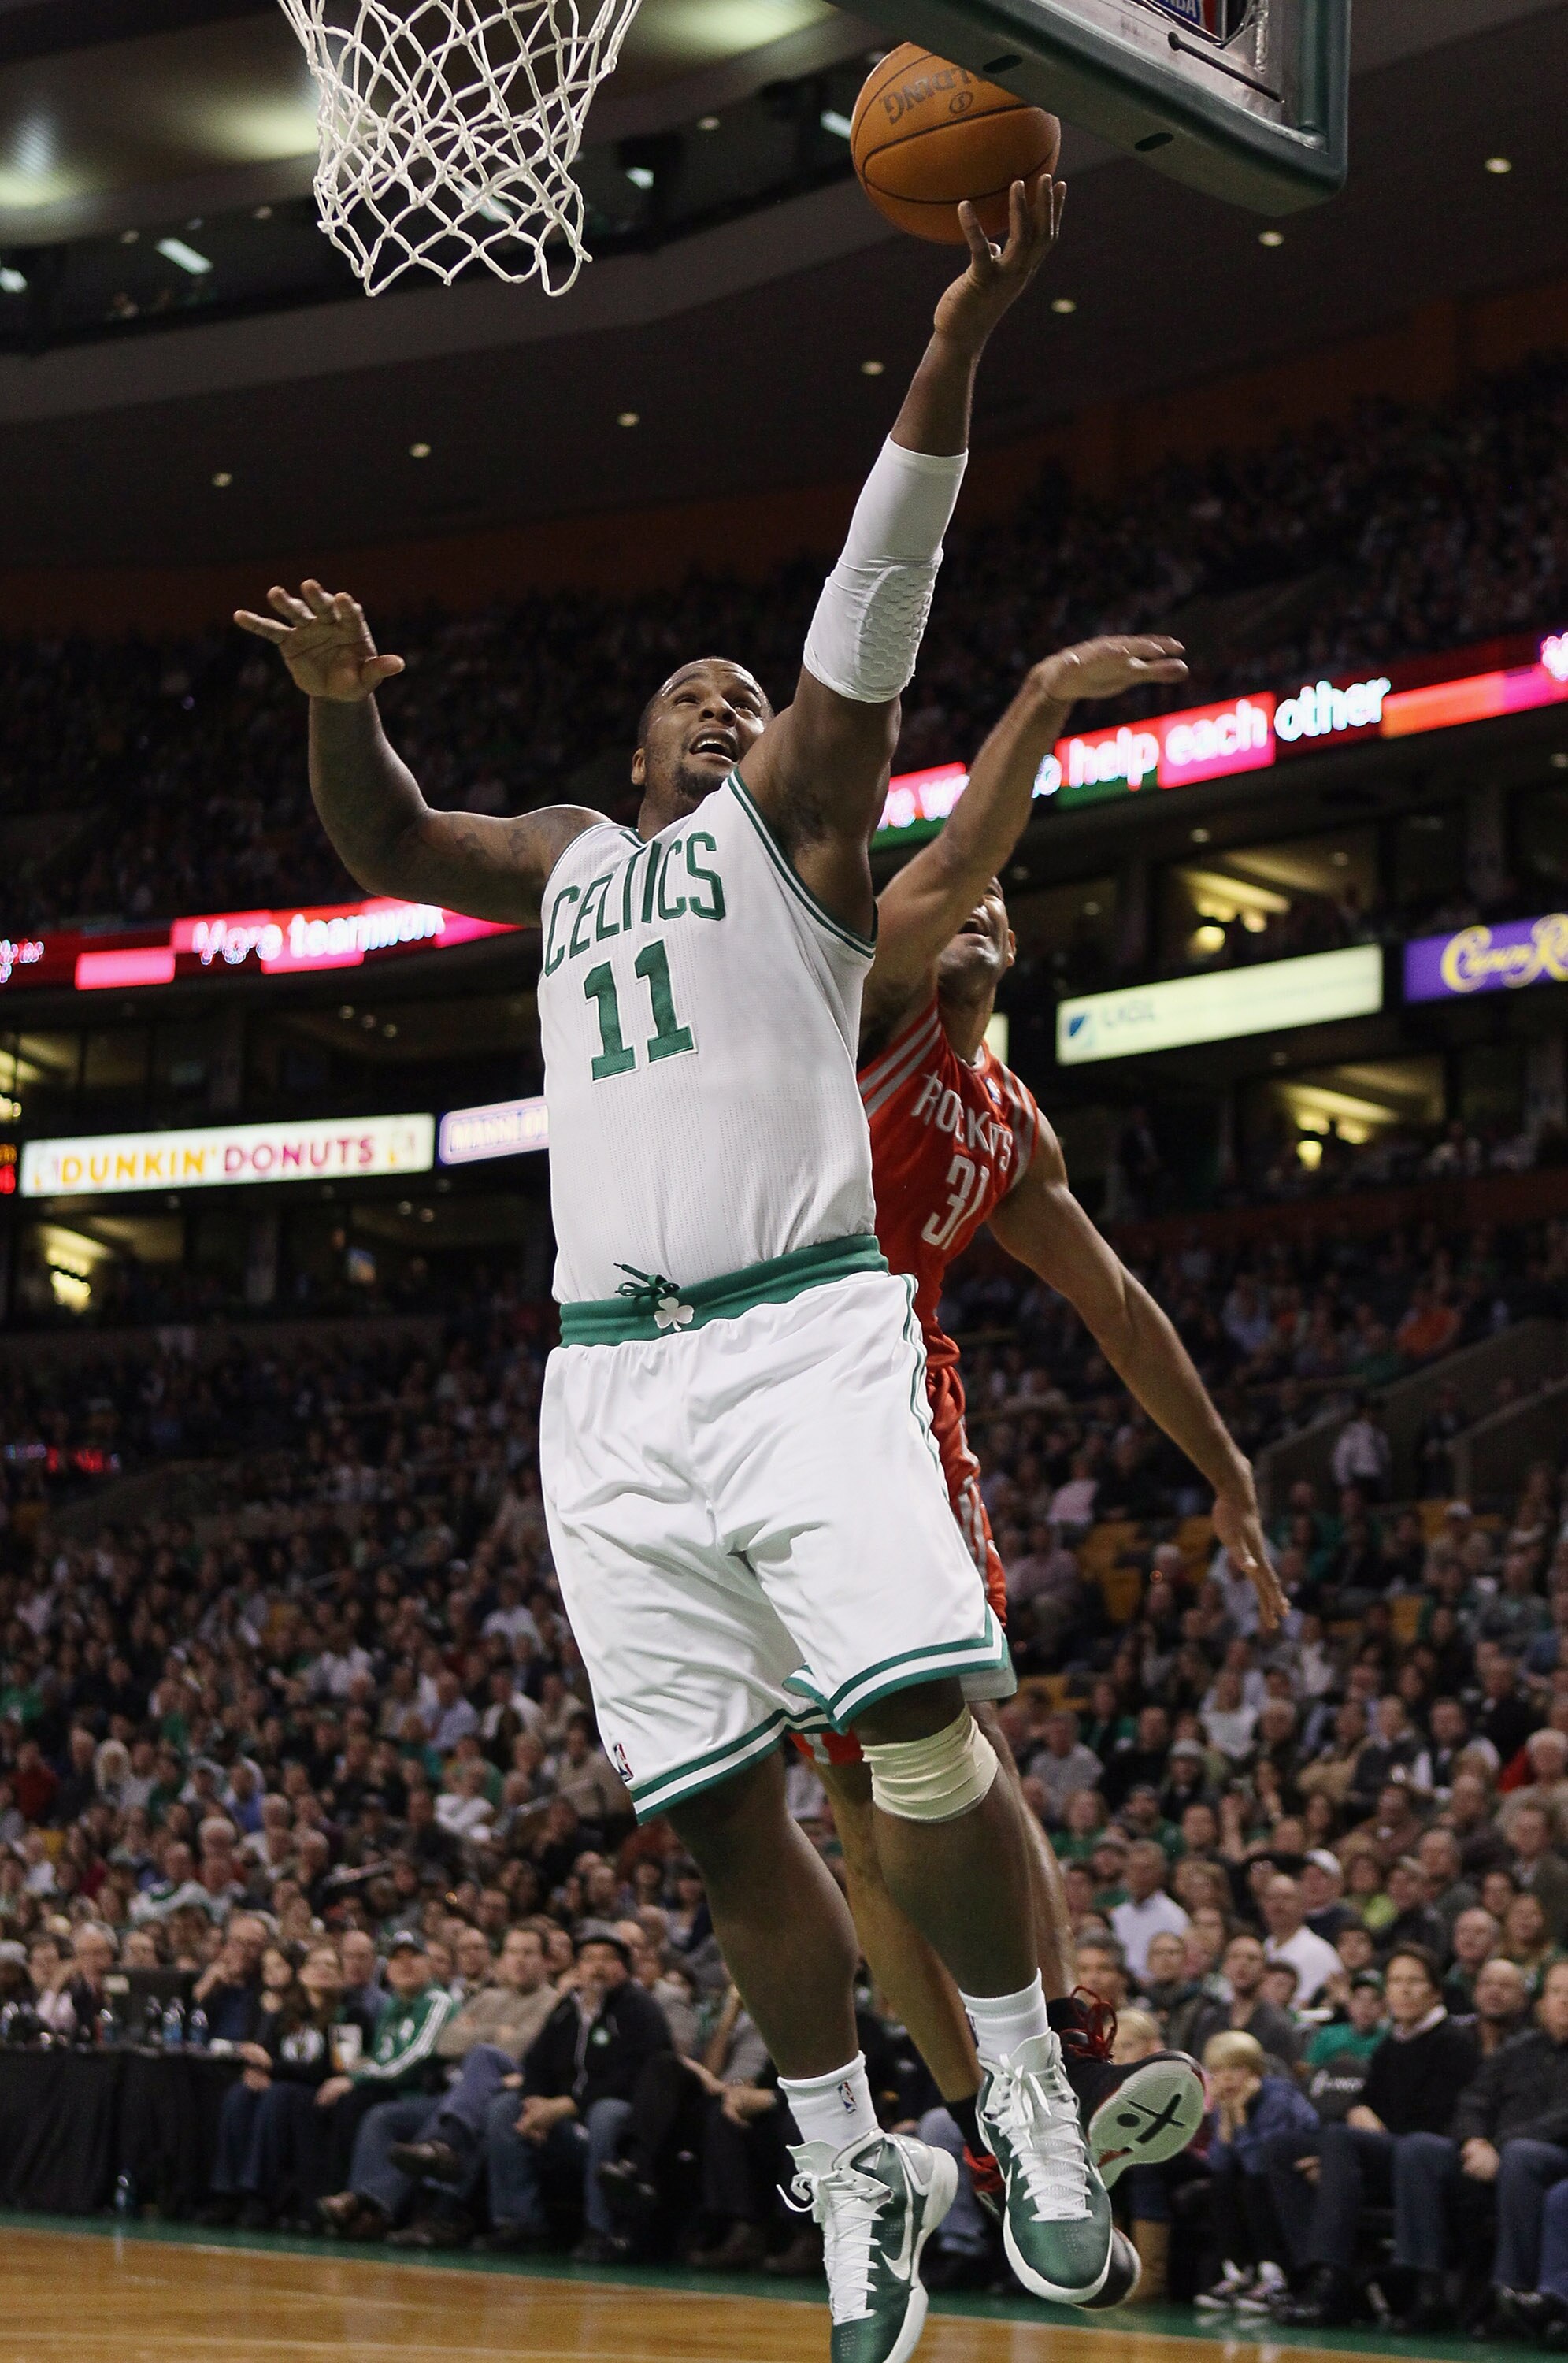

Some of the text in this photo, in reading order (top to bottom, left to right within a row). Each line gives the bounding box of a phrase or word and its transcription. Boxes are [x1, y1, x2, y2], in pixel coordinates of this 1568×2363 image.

[883, 67, 972, 125] LDING
[1069, 727, 1159, 790] help
[1165, 699, 1268, 766] each
[1273, 677, 1392, 742] other
[544, 831, 726, 977] CELTICS
[583, 938, 699, 1081] 11
[224, 1136, 375, 1174] DONUTS
[910, 1070, 1014, 1173] ROCKTS
[921, 1154, 991, 1250] 31
